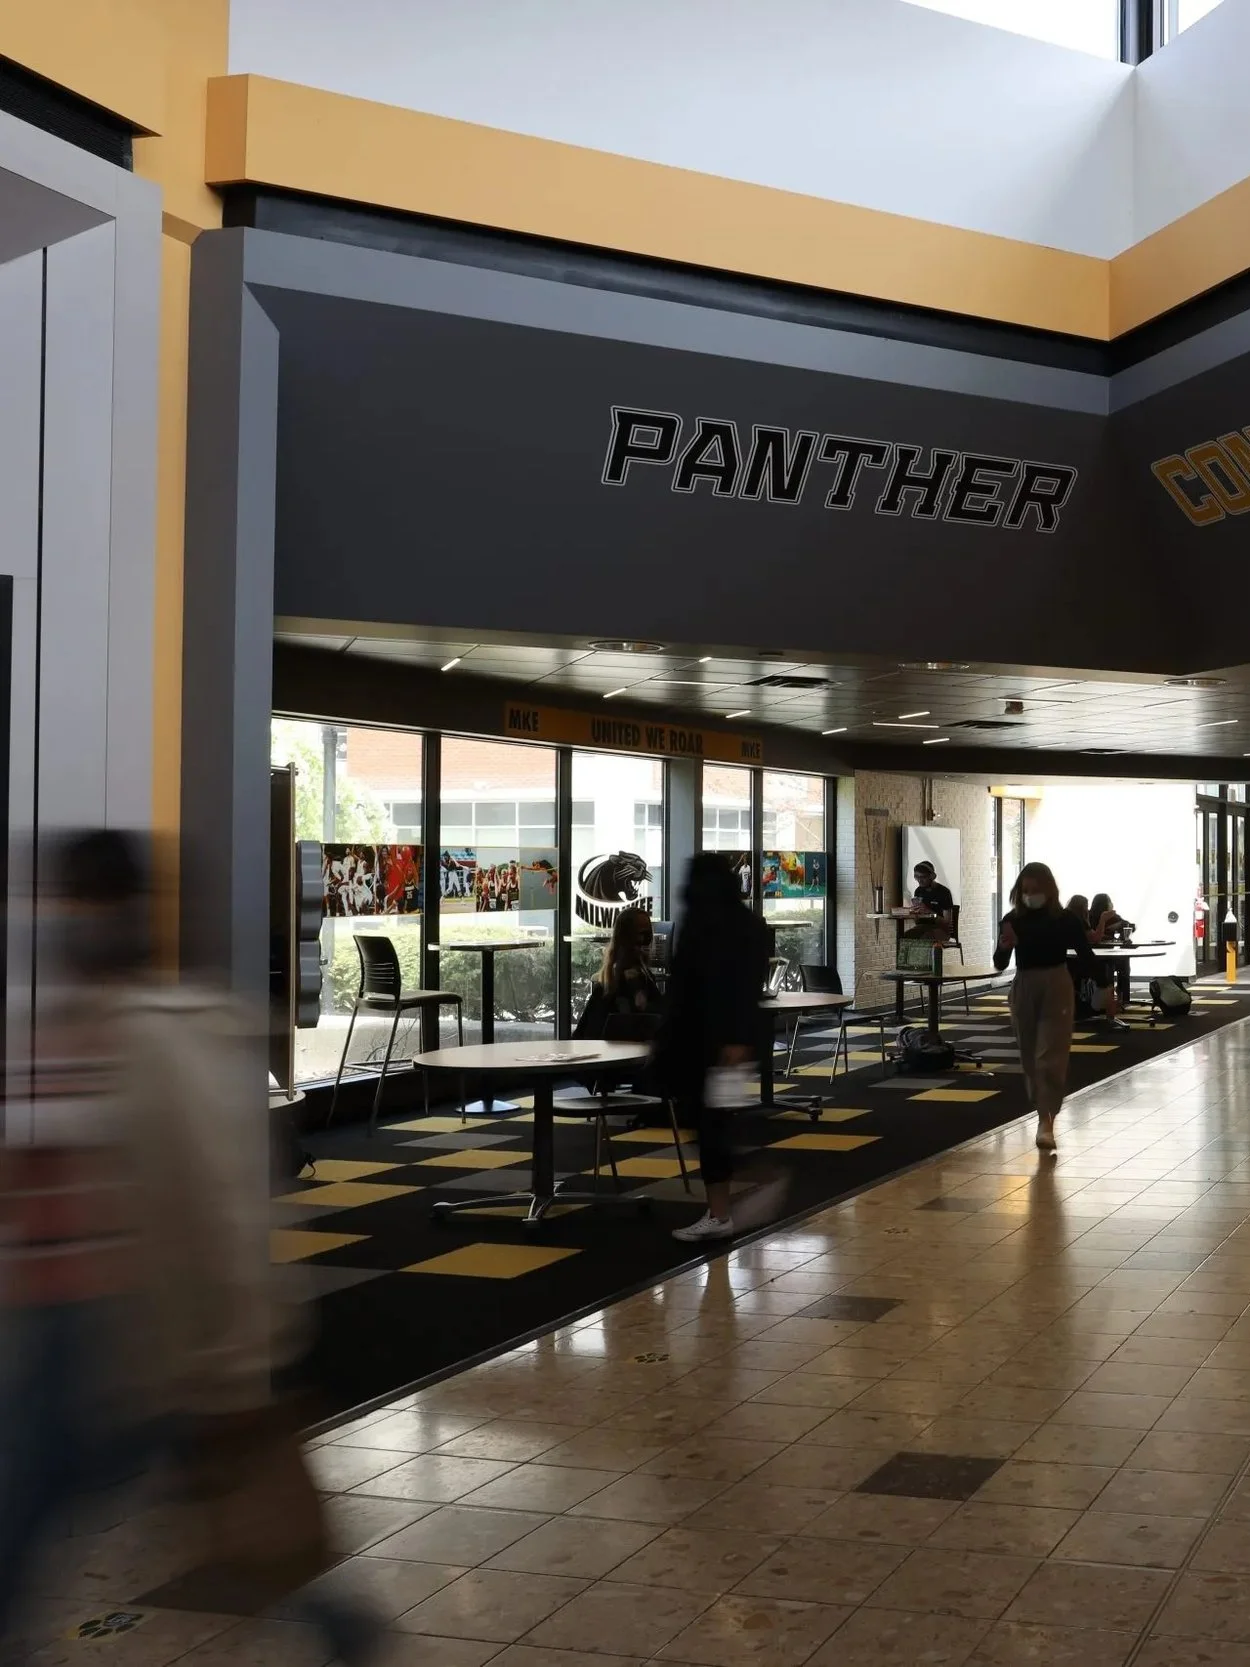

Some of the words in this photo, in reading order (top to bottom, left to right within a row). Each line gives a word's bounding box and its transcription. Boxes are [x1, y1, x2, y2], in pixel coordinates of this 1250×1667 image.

[600, 404, 1078, 533] PANTHER
[509, 708, 539, 732] MKE
[591, 717, 640, 747] UNITED
[645, 727, 665, 749] WE
[670, 730, 703, 754] ROAR
[741, 740, 760, 759] MKE
